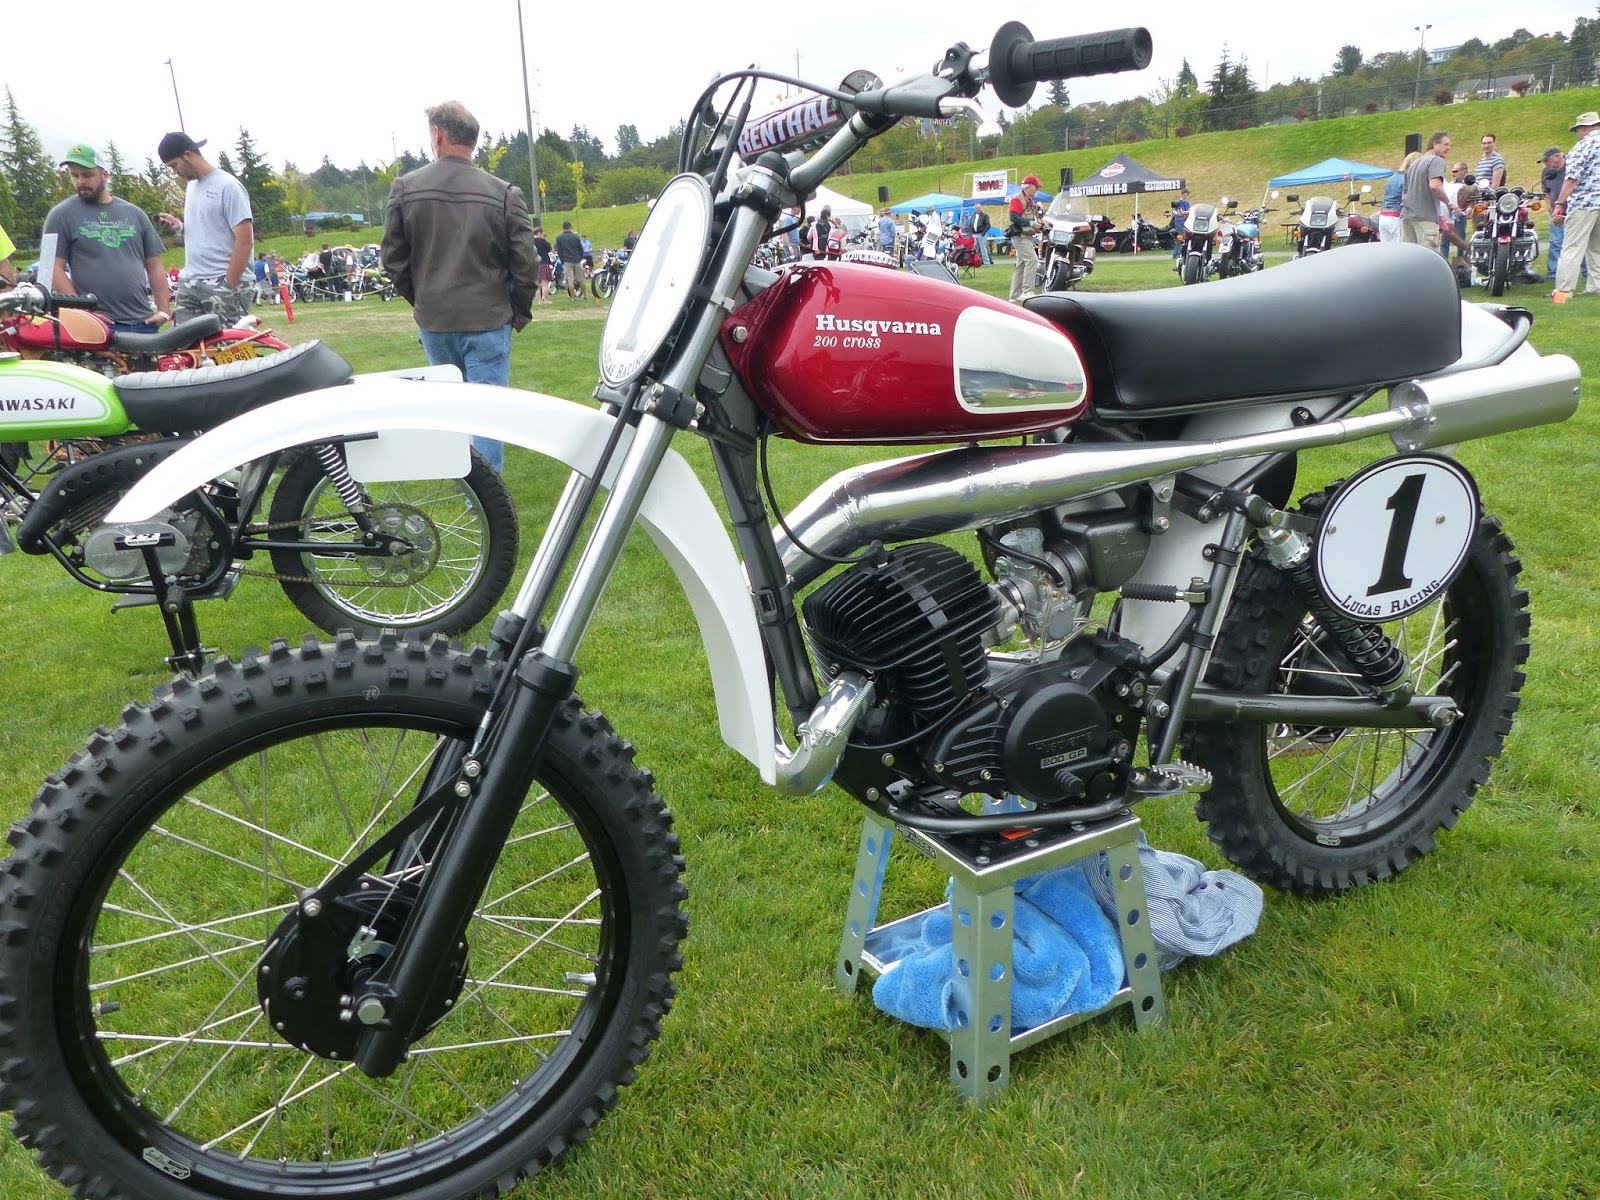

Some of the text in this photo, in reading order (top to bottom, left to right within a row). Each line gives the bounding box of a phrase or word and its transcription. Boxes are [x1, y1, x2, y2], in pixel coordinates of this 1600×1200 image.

[738, 99, 838, 154] RENTHAL
[1069, 184, 1114, 198] DESTINATION
[616, 203, 685, 352] 1
[815, 314, 942, 337] Husqvarna
[813, 335, 882, 349] 200 cross
[616, 349, 648, 380] RACING
[1366, 473, 1427, 597] 1
[1341, 579, 1440, 616] LUCAS RACING
[1042, 749, 1085, 767] 200 GP
